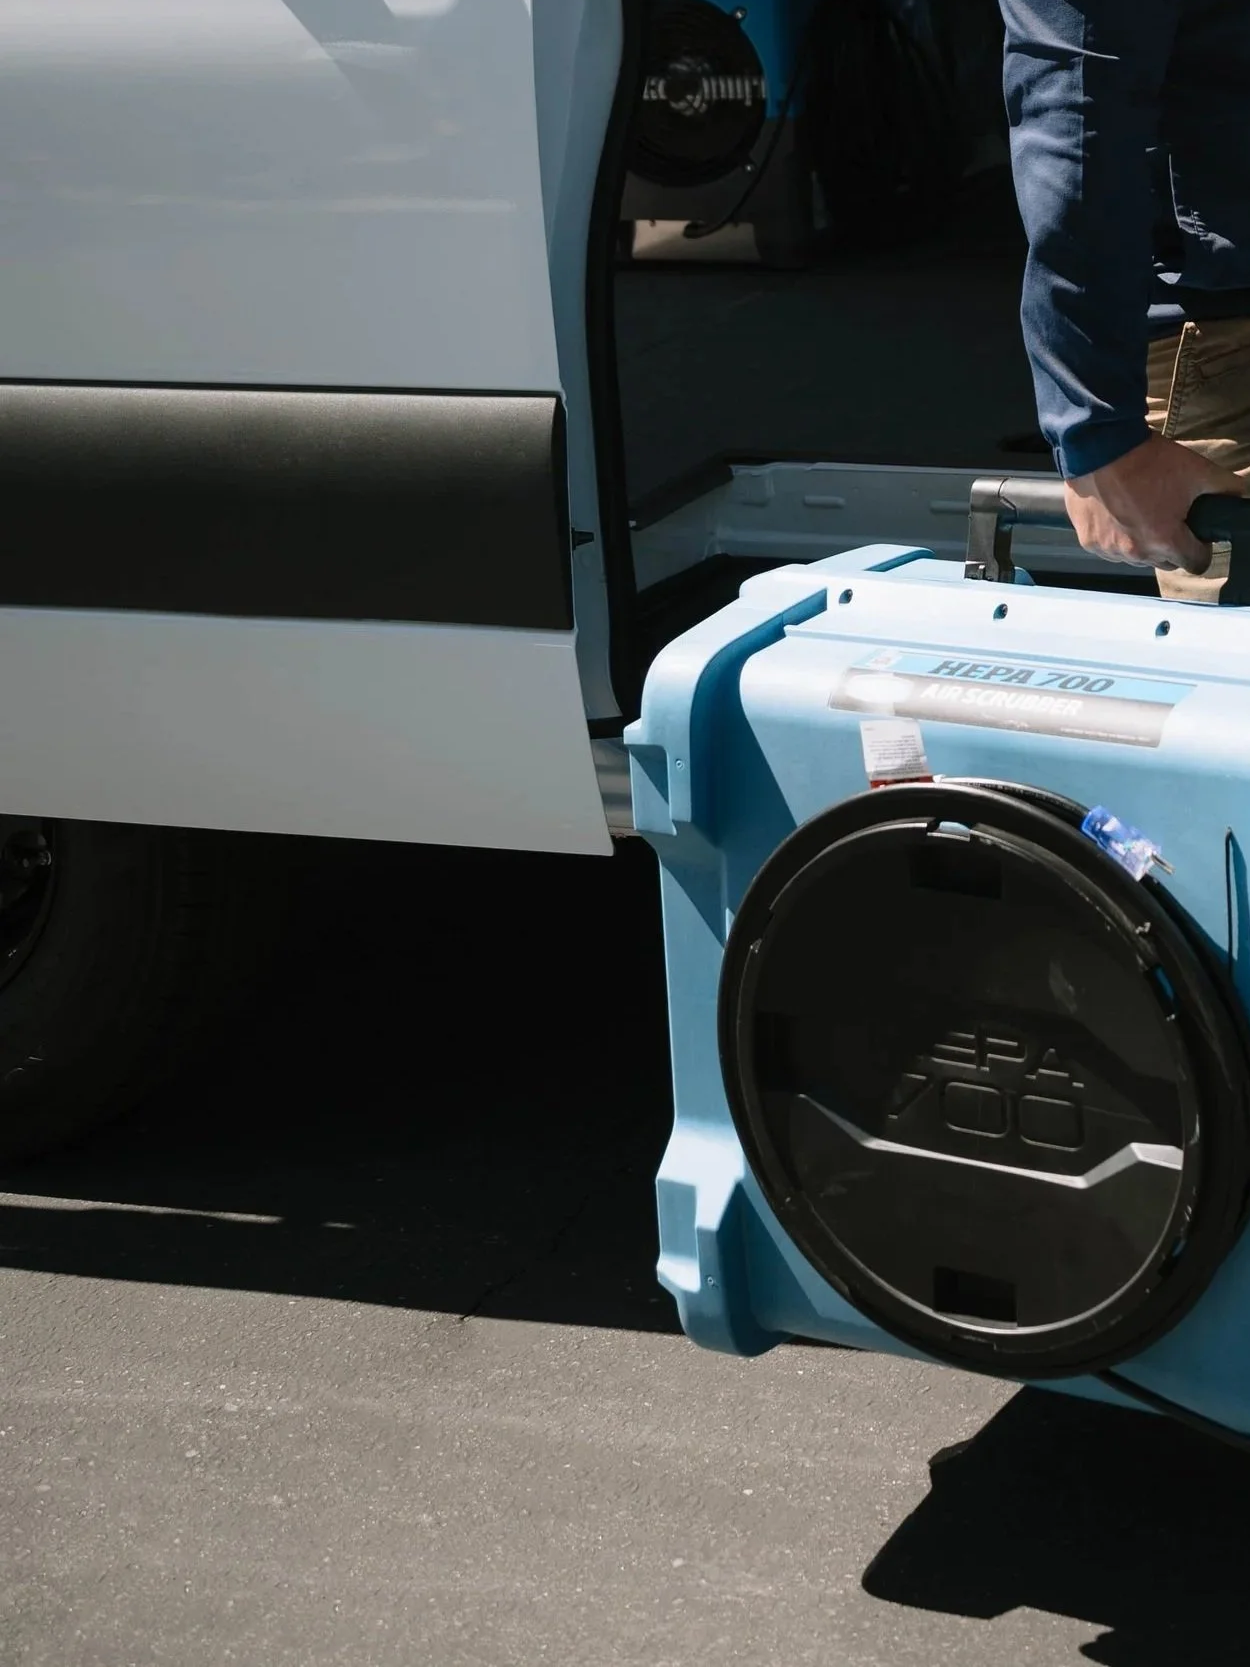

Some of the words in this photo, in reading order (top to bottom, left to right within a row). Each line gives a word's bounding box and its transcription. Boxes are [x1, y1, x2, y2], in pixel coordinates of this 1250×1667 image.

[928, 660, 1036, 684] HEPA
[1036, 673, 1115, 693] 700
[920, 683, 962, 701] AIR
[961, 689, 1084, 715] SCRUBBER
[887, 1071, 1086, 1153] 700
